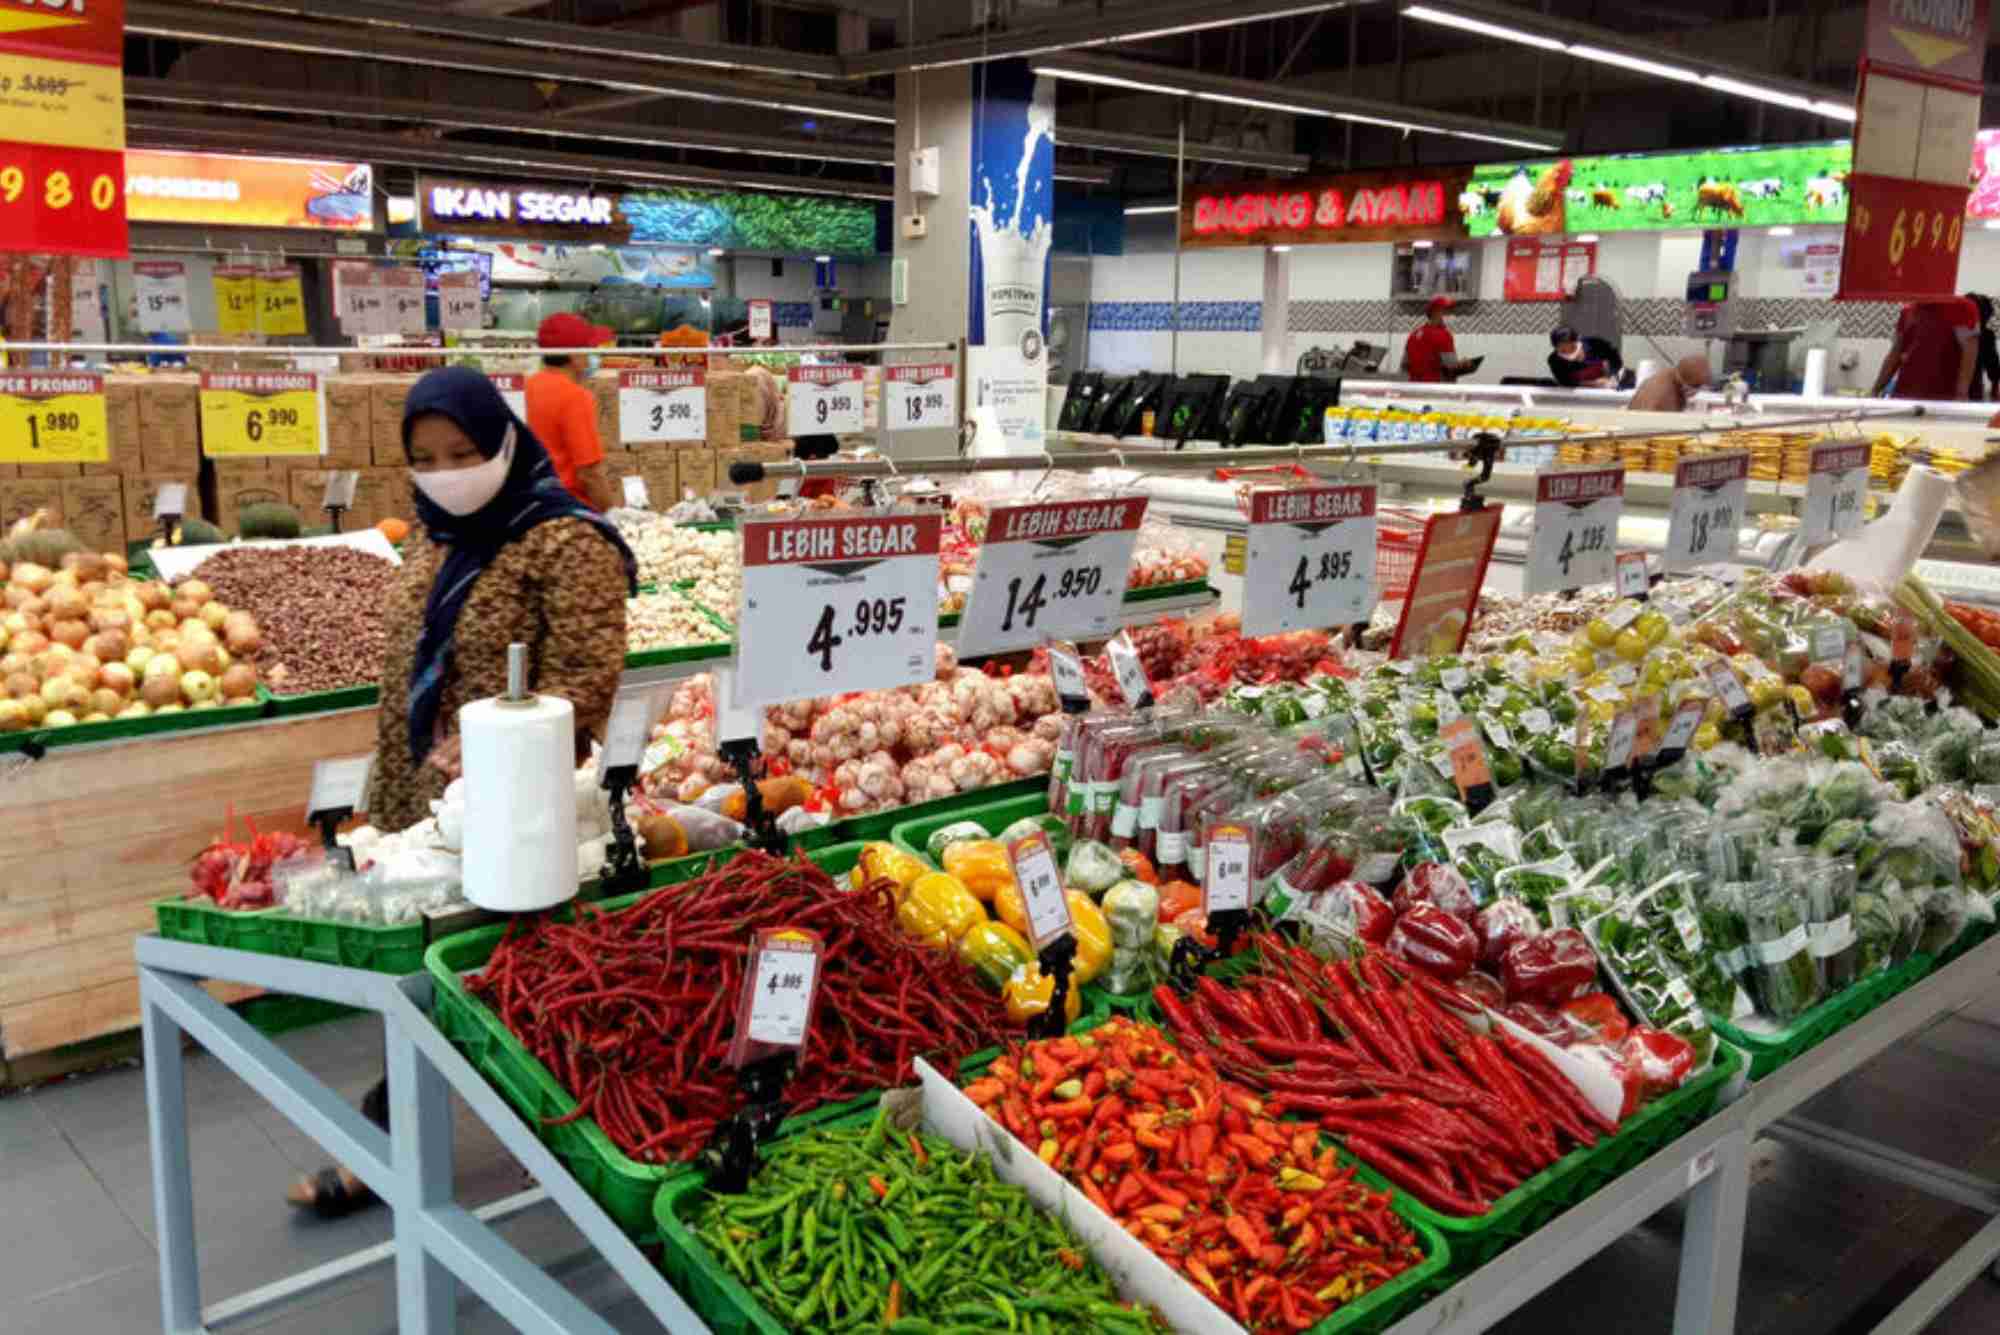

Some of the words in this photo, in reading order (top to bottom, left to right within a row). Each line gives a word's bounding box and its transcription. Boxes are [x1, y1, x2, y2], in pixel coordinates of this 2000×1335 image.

[432, 187, 511, 218] IKAN
[517, 191, 612, 223] SEGAR
[1194, 192, 1310, 234] DAGING
[1314, 189, 1341, 226] &
[1346, 180, 1444, 225] AYAM
[31, 378, 94, 393] PROMO!
[208, 375, 253, 389] SUPER
[257, 375, 311, 389] PROMO!
[1006, 509, 1063, 538] LEBIH
[1064, 504, 1128, 531] SEGAR
[1268, 494, 1311, 519] LEBIH
[1314, 492, 1363, 517] SEGAR
[767, 527, 835, 561] LEBIH
[842, 524, 917, 556] SEGAR
[806, 597, 906, 672] 4.995
